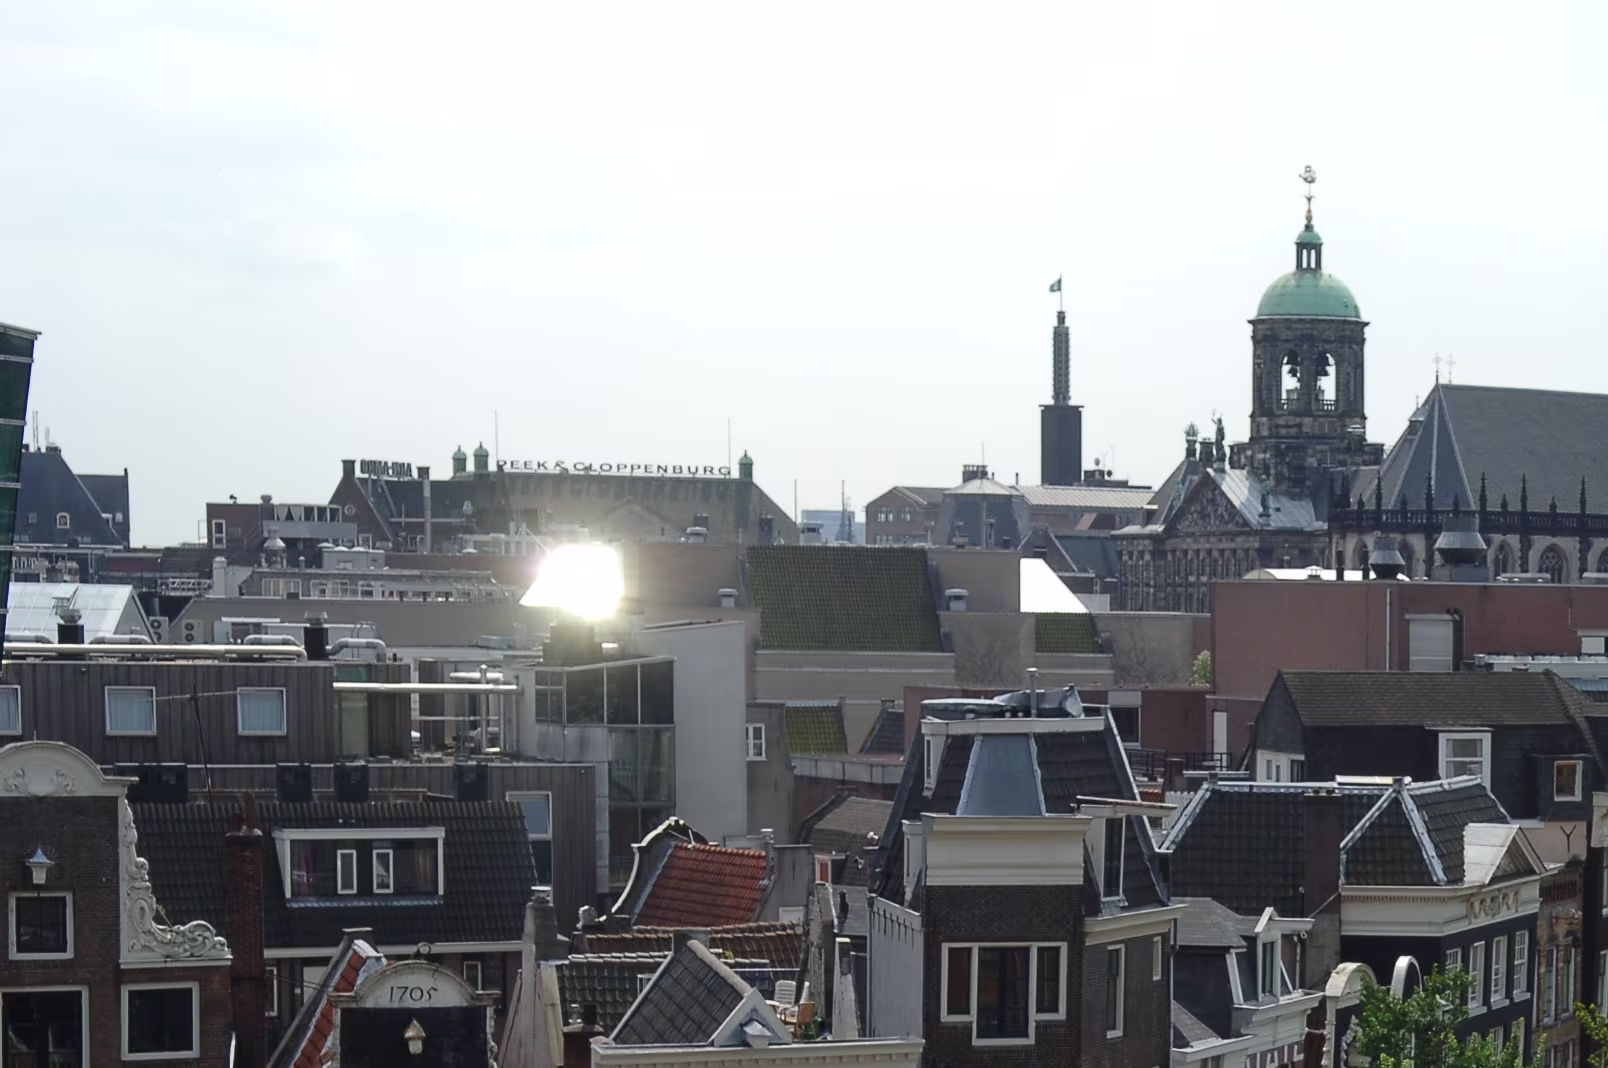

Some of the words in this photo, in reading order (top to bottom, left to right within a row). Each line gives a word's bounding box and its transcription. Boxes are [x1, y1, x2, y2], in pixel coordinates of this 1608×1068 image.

[496, 459, 548, 471] PEEK
[553, 460, 568, 471] &
[573, 461, 731, 476] CLOPPENBURG
[389, 986, 439, 1002] 1705
